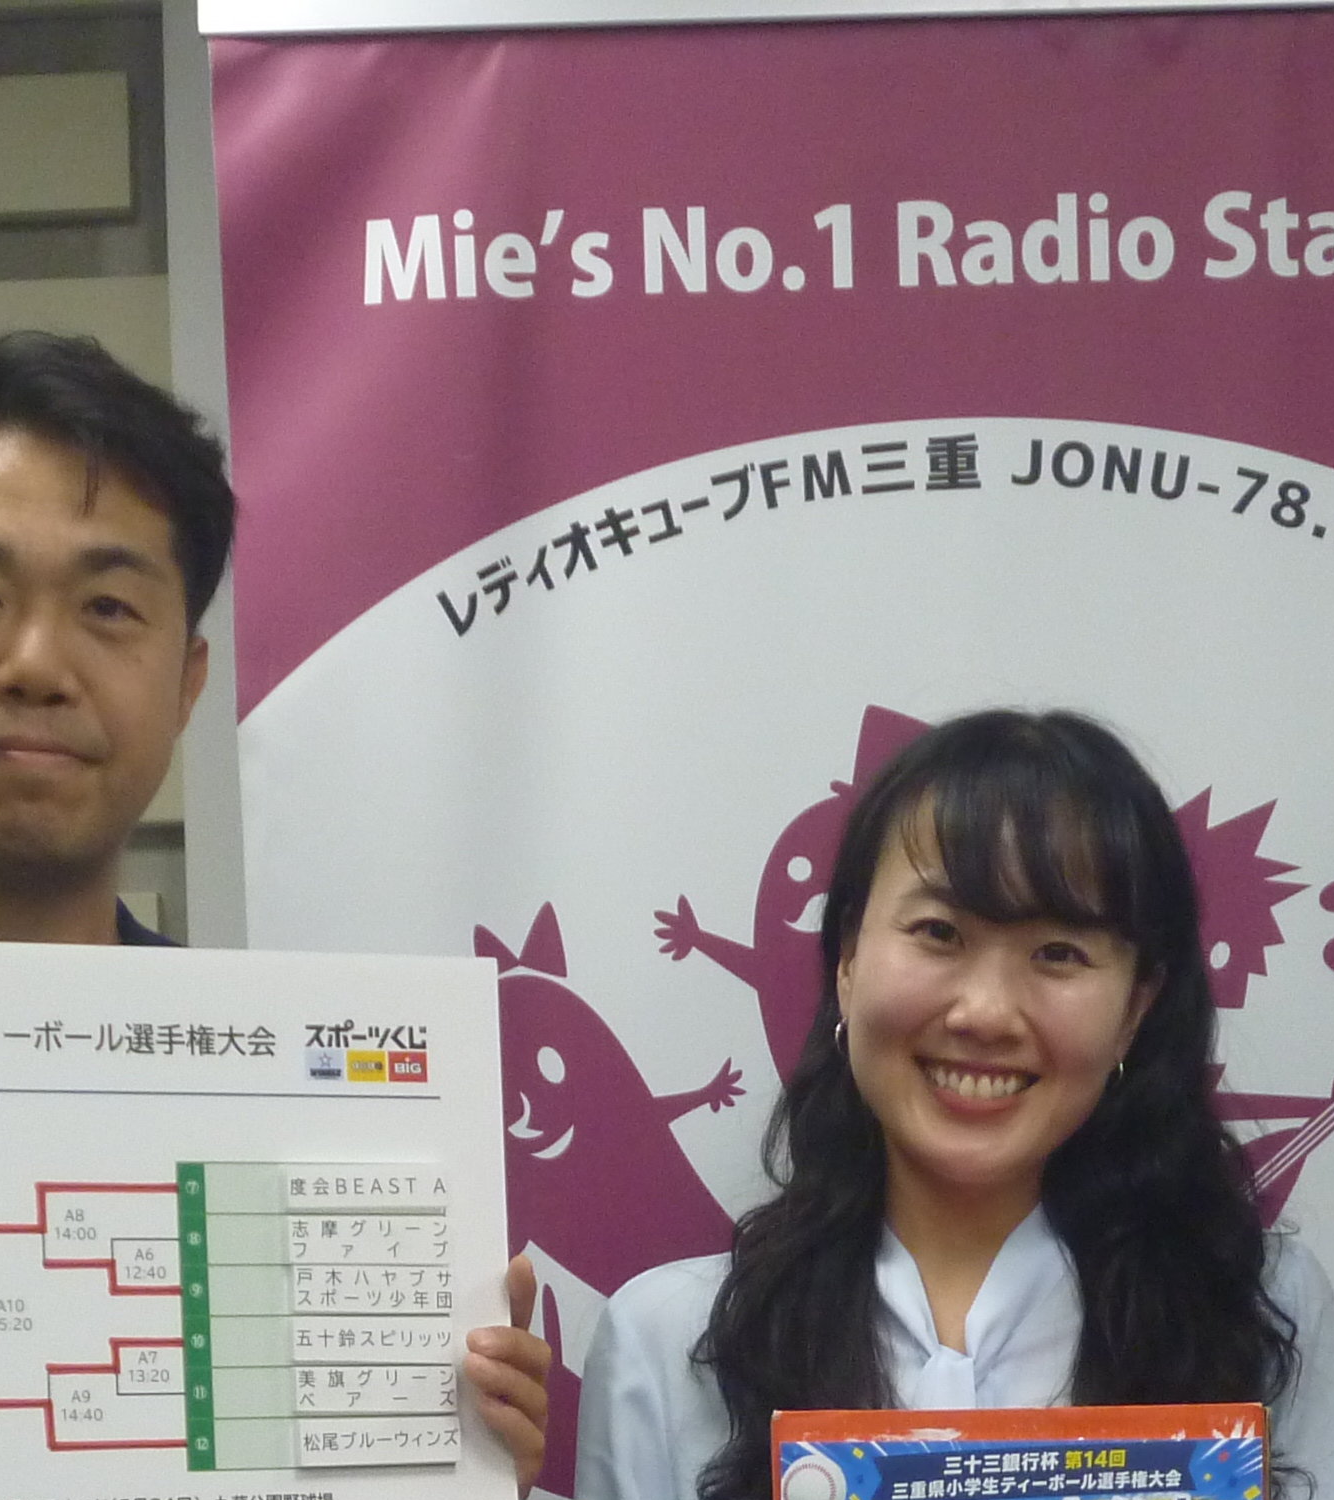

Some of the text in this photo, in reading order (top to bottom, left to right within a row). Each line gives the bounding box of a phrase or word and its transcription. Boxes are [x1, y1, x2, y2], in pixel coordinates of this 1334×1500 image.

[642, 203, 857, 294] No.1
[896, 192, 1175, 287] Radio
[436, 432, 981, 637] レディオキューブFM三重
[305, 1019, 427, 1049] スポーツくじ
[54, 1226, 97, 1241] 14:00
[296, 1289, 453, 1310] スポーツ少年団
[296, 1328, 452, 1349] 五十鈴スピリッツ
[943, 1449, 1127, 1476] 三十三銀行杯 第14回
[892, 1470, 1182, 1500] 三重県小学生ティーボール選手権大会
